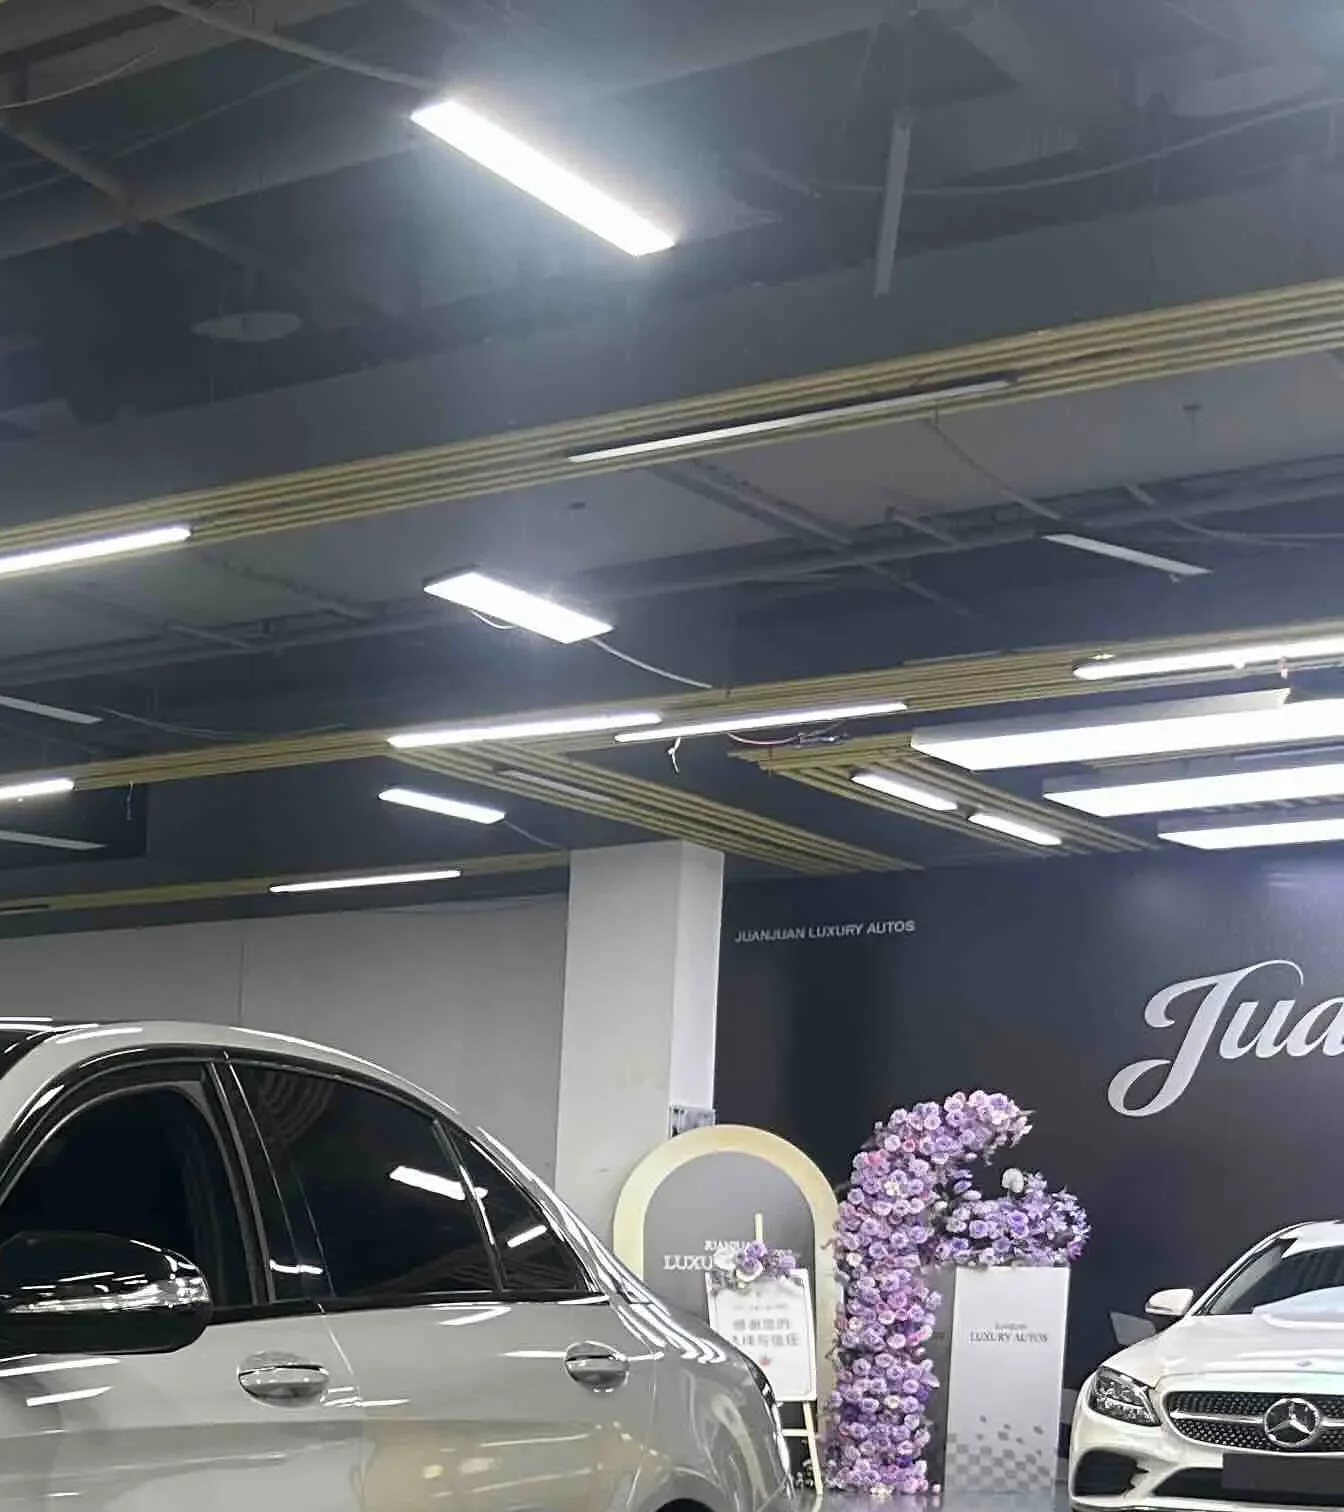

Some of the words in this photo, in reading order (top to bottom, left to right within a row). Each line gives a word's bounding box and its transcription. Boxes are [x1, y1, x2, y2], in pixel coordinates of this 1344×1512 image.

[734, 926, 806, 943] JUANJUAN
[808, 923, 863, 938] LUXURY
[866, 920, 916, 935] AUTOS
